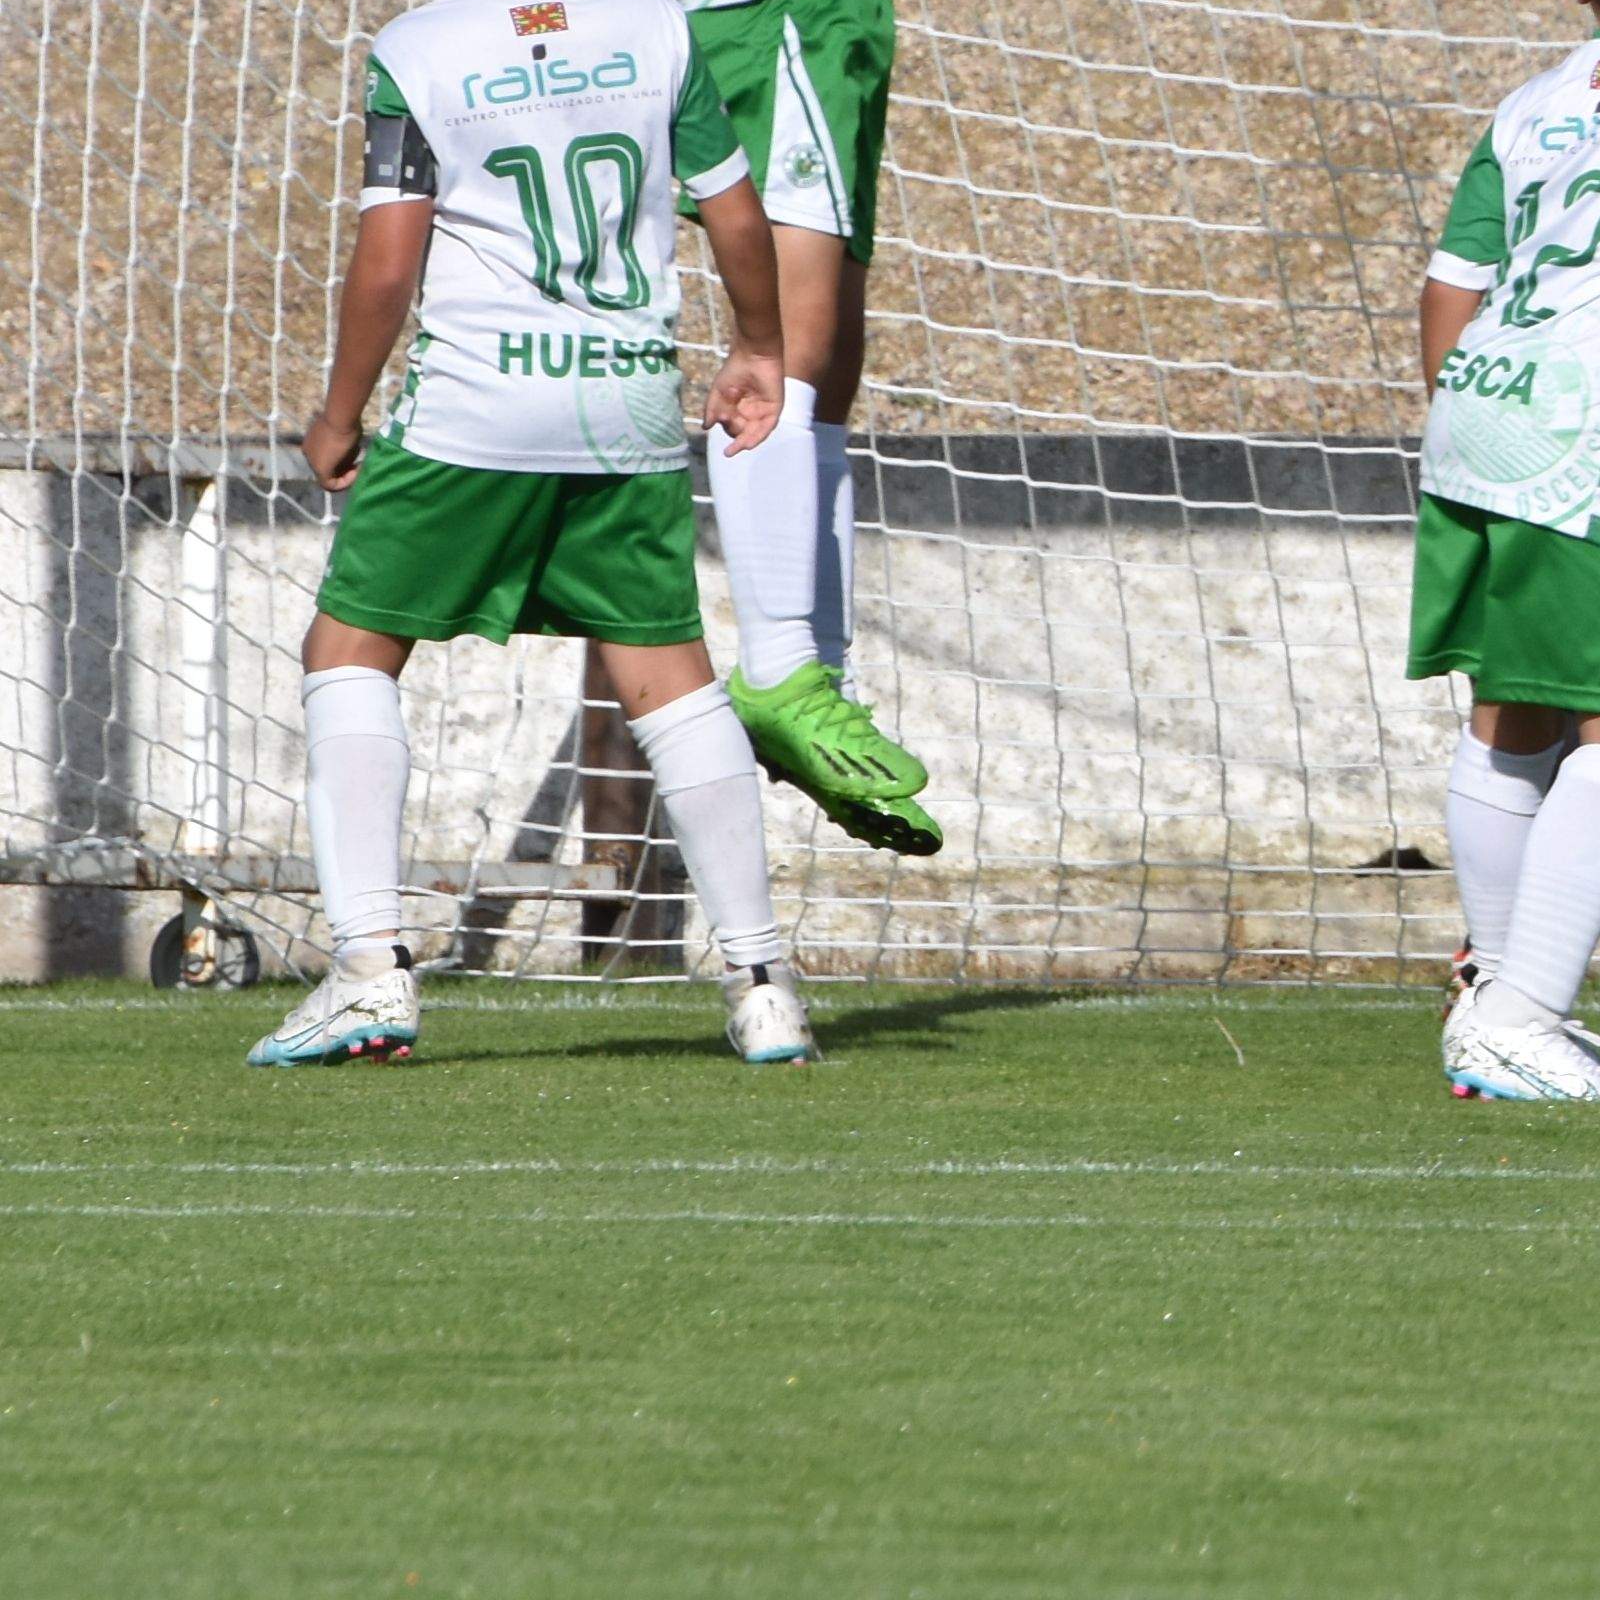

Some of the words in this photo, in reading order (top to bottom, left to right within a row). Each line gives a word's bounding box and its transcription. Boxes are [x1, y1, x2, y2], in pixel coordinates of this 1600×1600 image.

[462, 43, 637, 109] raisa
[444, 110, 498, 127] CENTRO
[504, 95, 604, 117] ESPECIALIZADO
[610, 92, 626, 102] EN
[483, 132, 650, 309] 10
